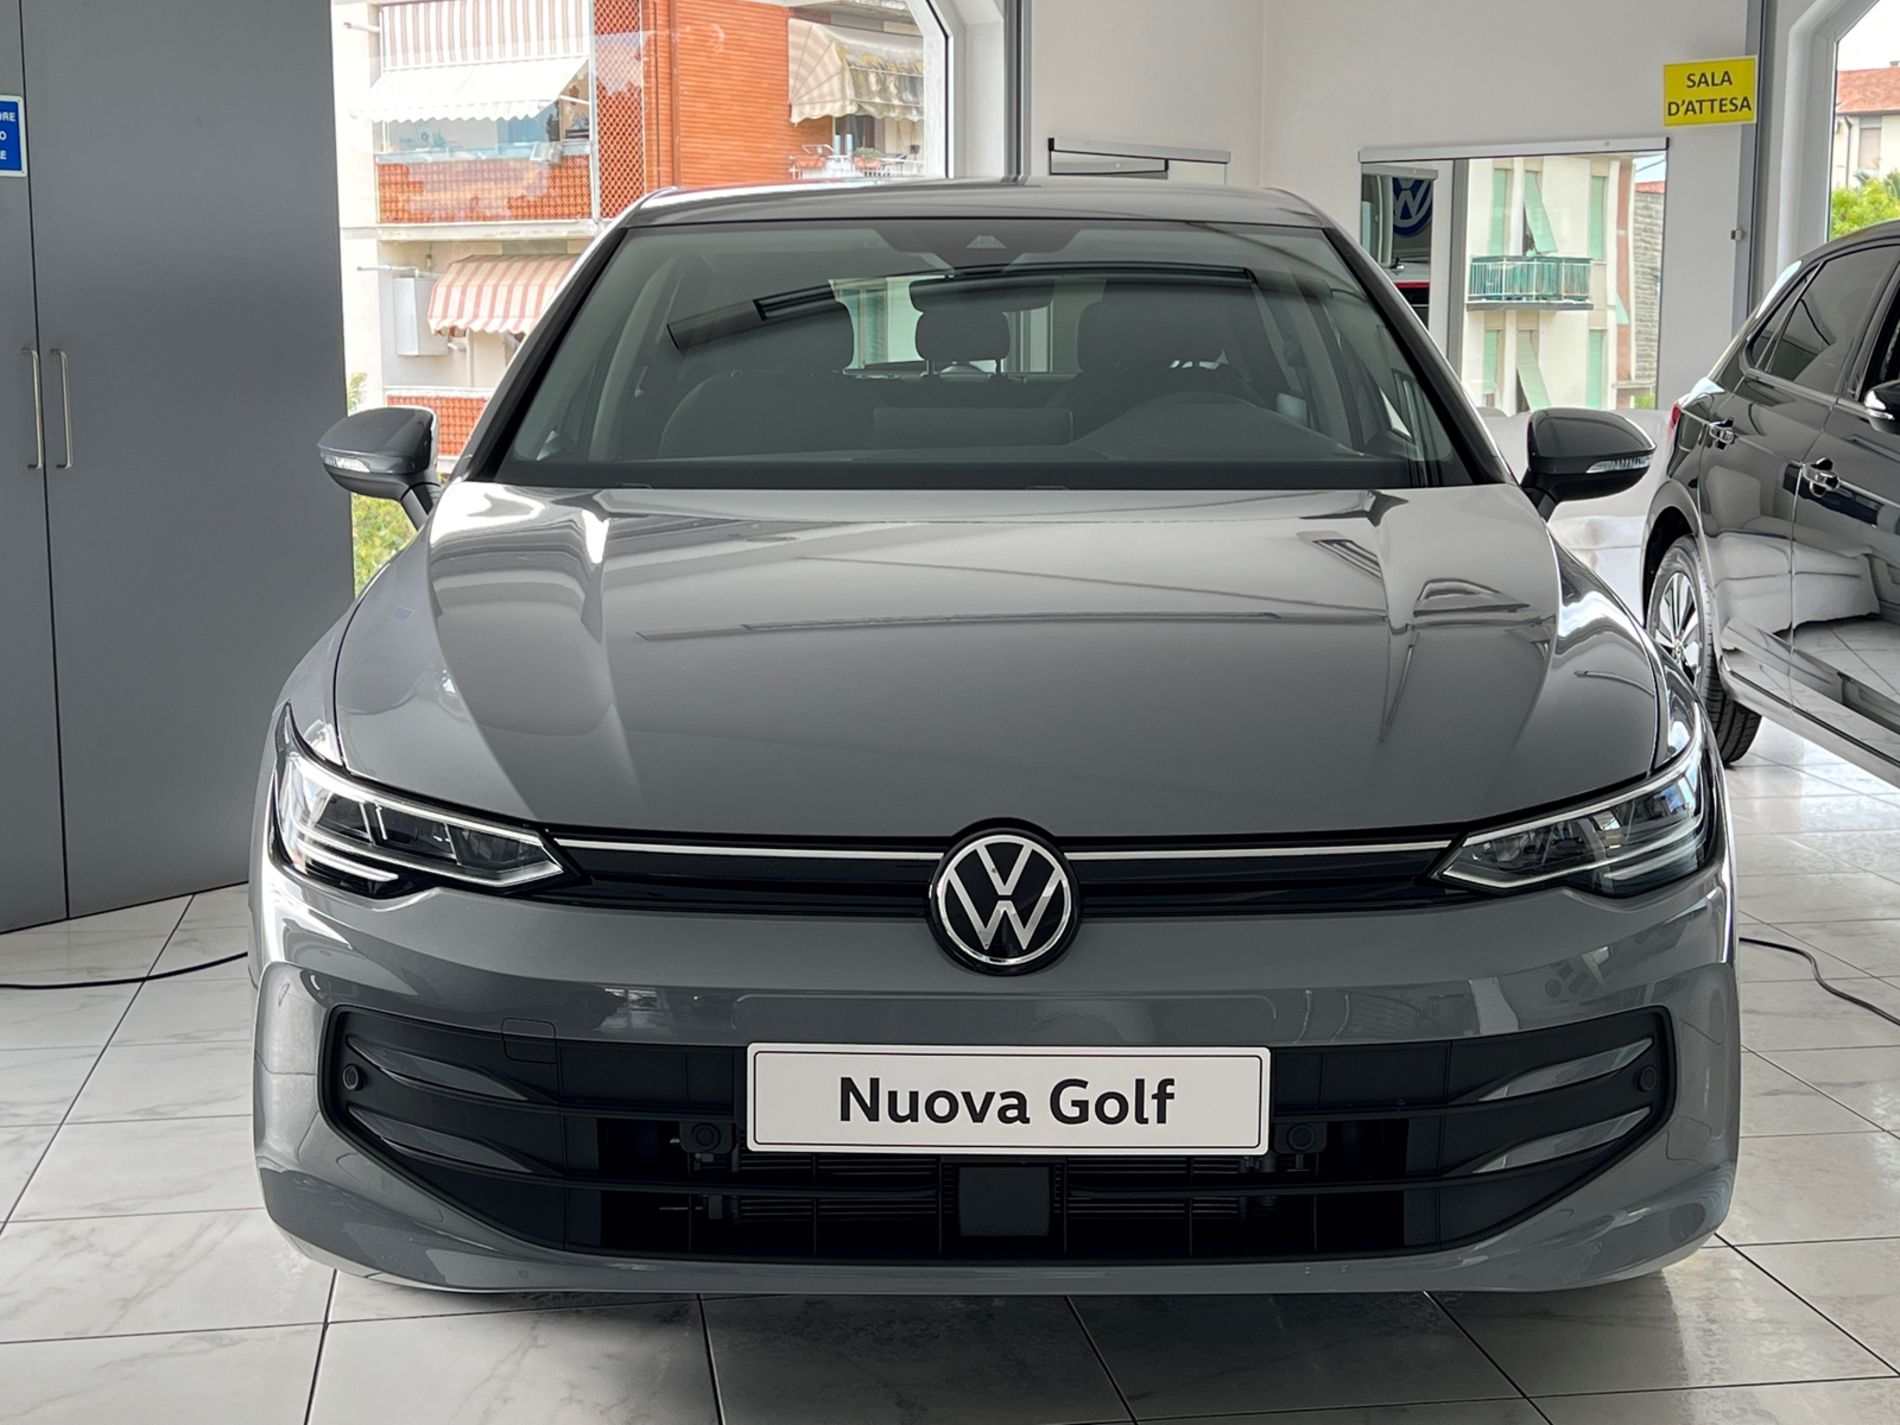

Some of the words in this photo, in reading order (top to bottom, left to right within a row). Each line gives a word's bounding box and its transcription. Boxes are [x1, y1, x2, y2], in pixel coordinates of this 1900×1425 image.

[1686, 70, 1733, 89] SALA
[0, 111, 17, 122] RE
[1667, 96, 1752, 117] D'ATTESA
[944, 838, 1065, 955] VW
[839, 1076, 1031, 1125] Nuova
[1049, 1077, 1175, 1125] Golf
